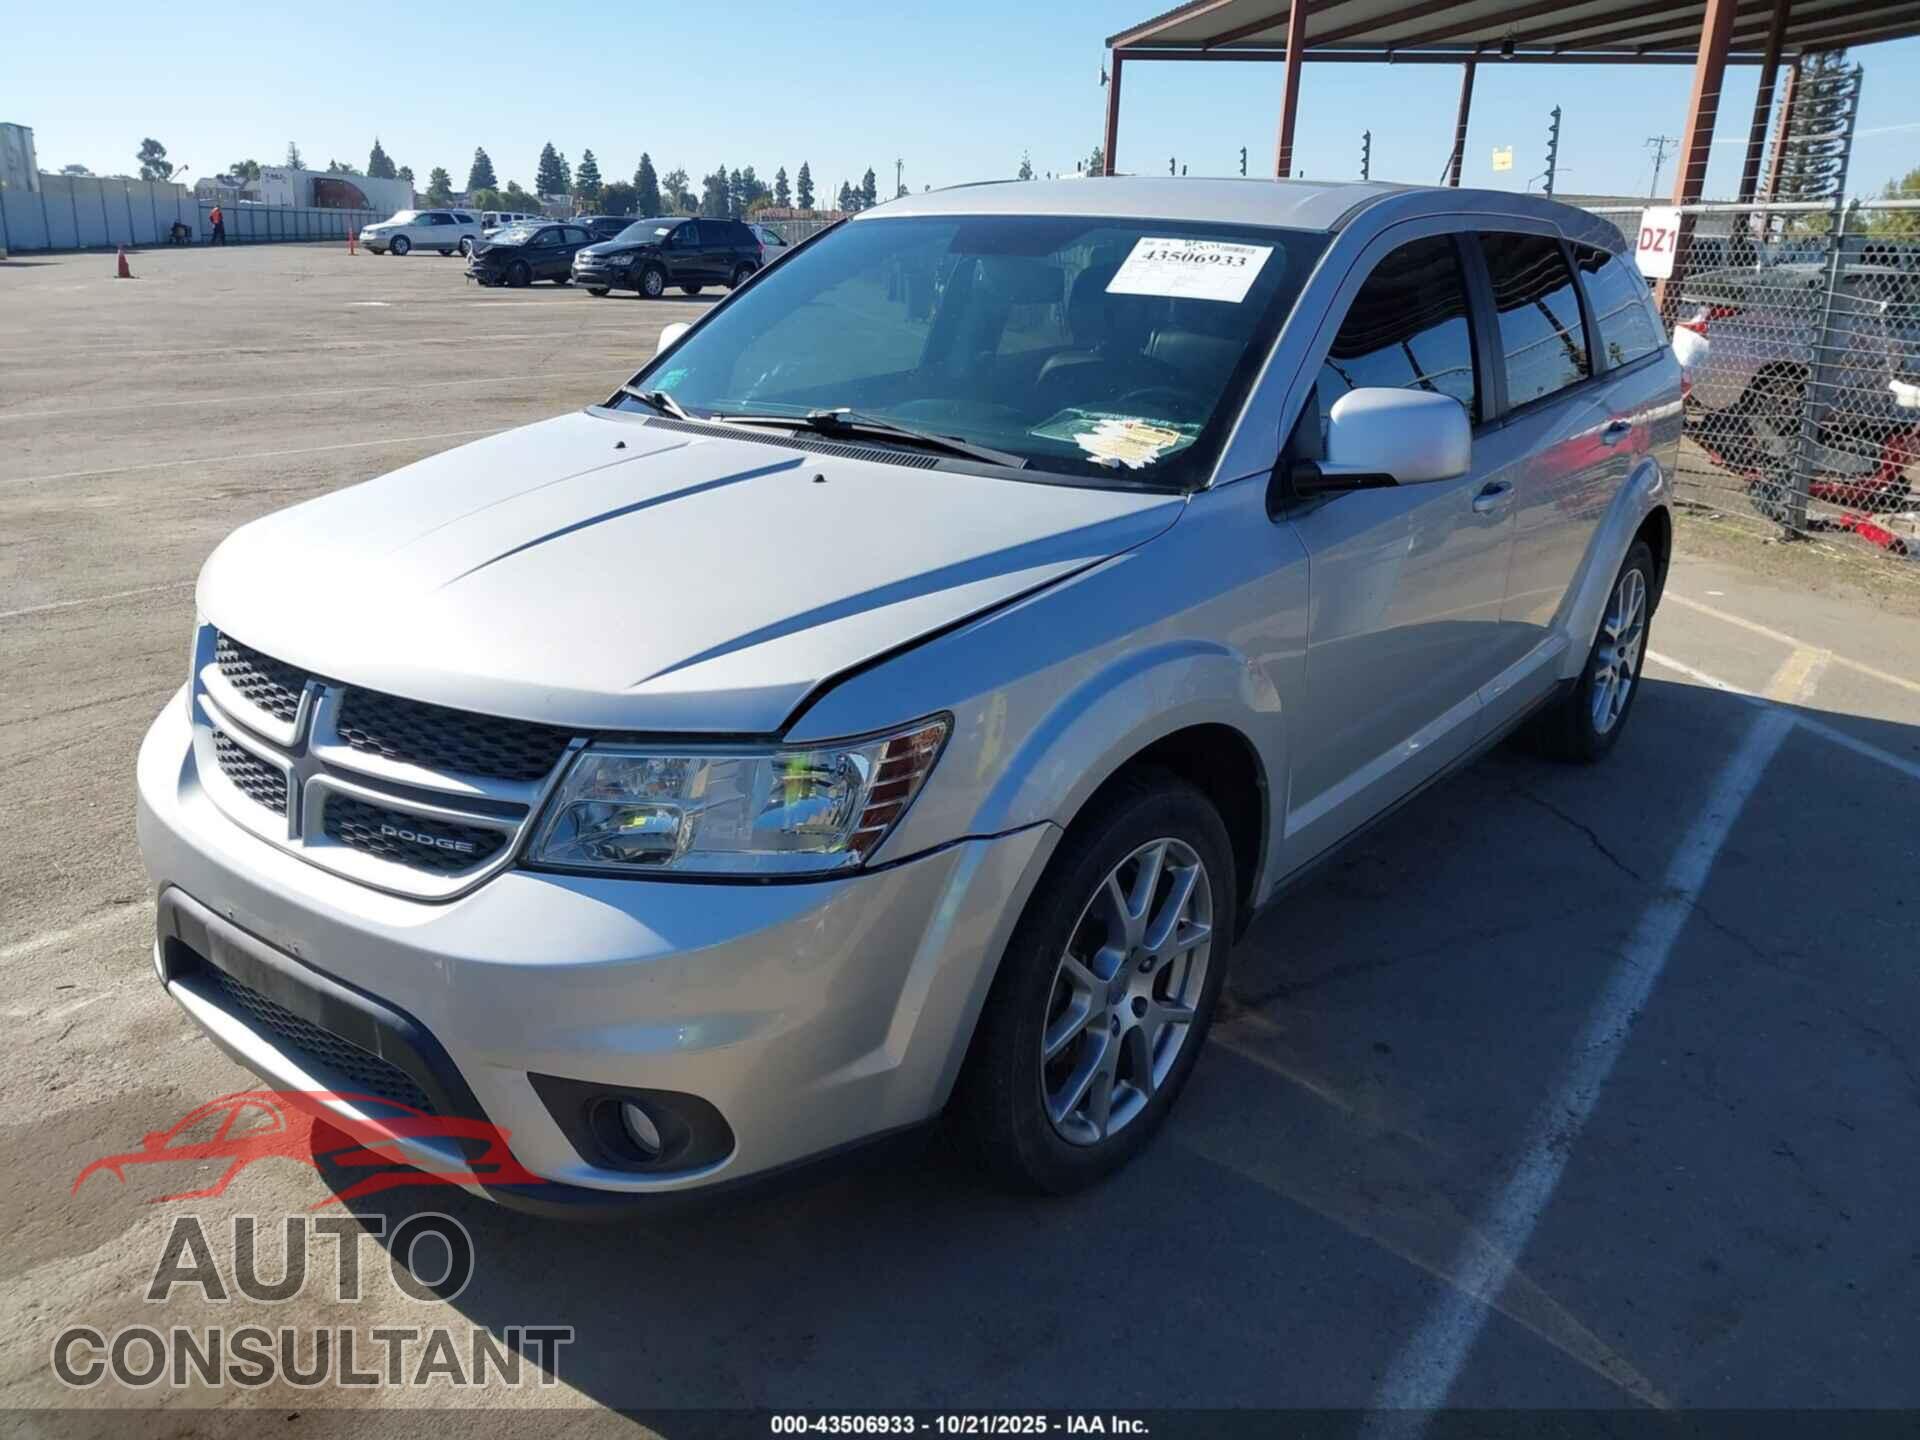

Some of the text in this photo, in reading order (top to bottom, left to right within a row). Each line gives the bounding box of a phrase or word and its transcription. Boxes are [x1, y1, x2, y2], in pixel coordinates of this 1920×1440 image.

[1639, 227, 1676, 252] DZ1
[1142, 249, 1247, 268] 43506933
[379, 823, 473, 852] DODGE
